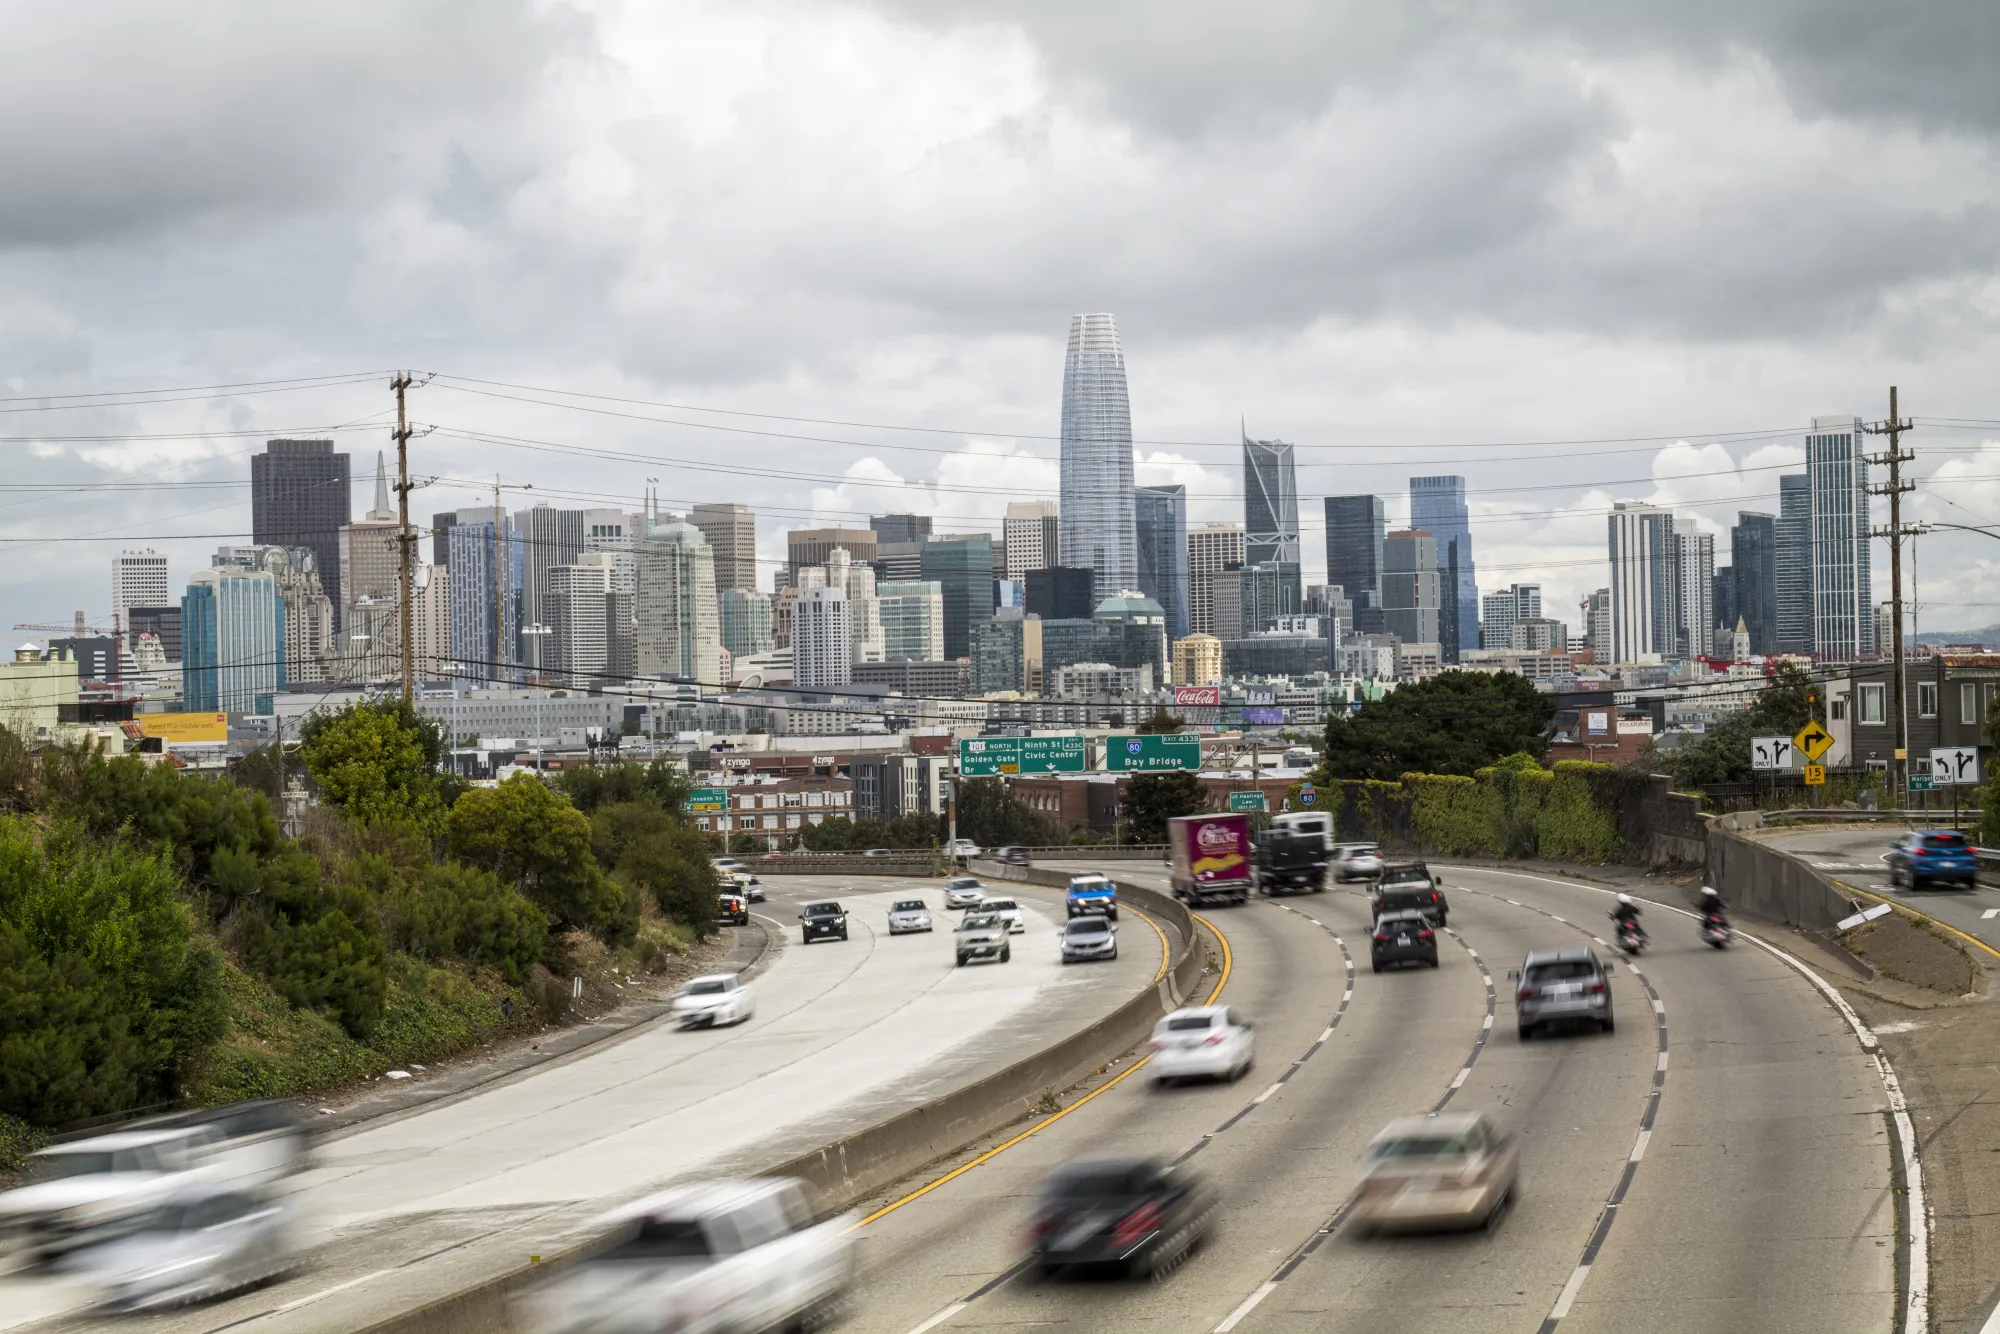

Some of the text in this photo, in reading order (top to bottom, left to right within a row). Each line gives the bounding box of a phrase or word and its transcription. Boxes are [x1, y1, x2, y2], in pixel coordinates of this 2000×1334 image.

[972, 742, 983, 750] 101
[1130, 743, 1140, 751] 80
[727, 758, 751, 767] zynga
[818, 756, 835, 765] zynga
[1125, 758, 1182, 767] Bay Bridge
[1809, 768, 1821, 776] 15
